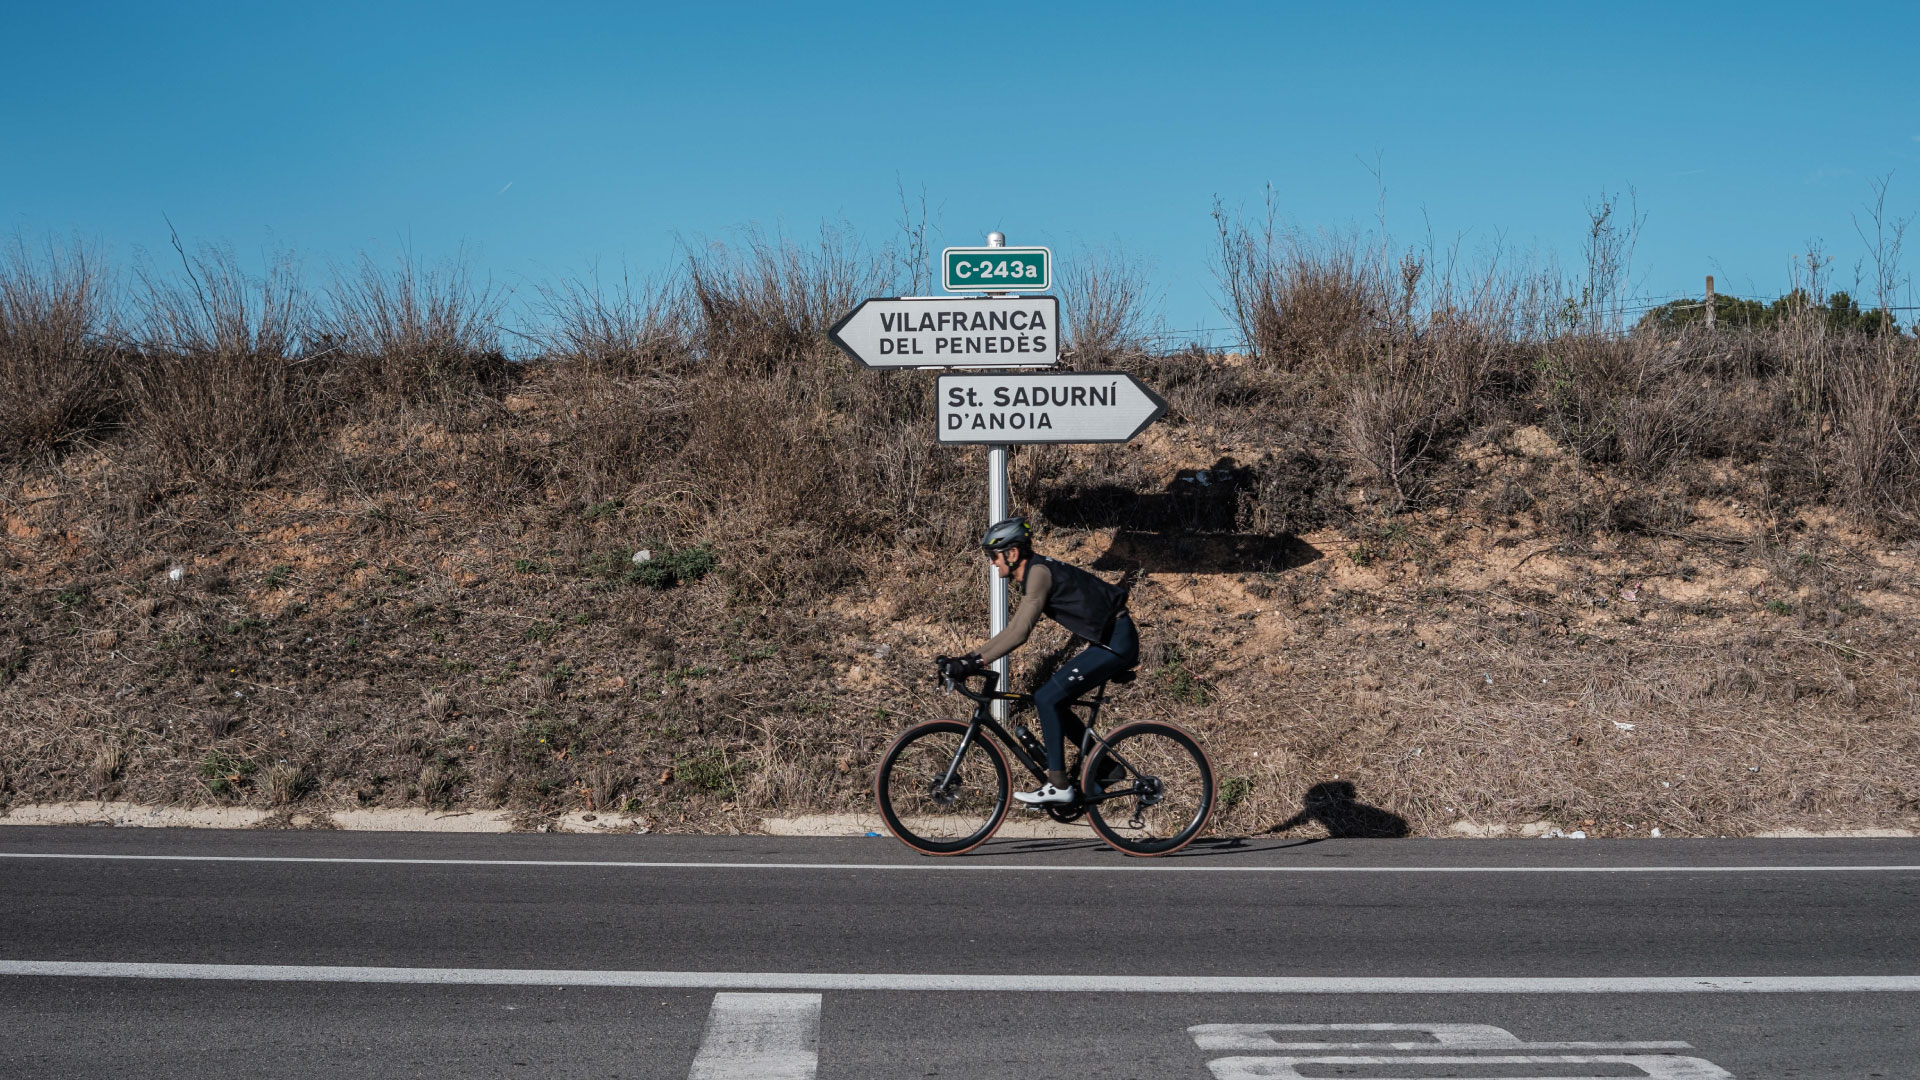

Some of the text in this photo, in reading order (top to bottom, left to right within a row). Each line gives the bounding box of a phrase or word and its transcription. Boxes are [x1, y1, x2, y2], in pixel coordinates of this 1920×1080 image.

[955, 260, 1038, 279] C-243a
[879, 310, 1047, 333] VILAFRANCA
[879, 332, 1047, 355] DEL PENEDÈS
[947, 381, 1118, 408] St. SADURNÍ
[947, 412, 1053, 430] D'ANOIA
